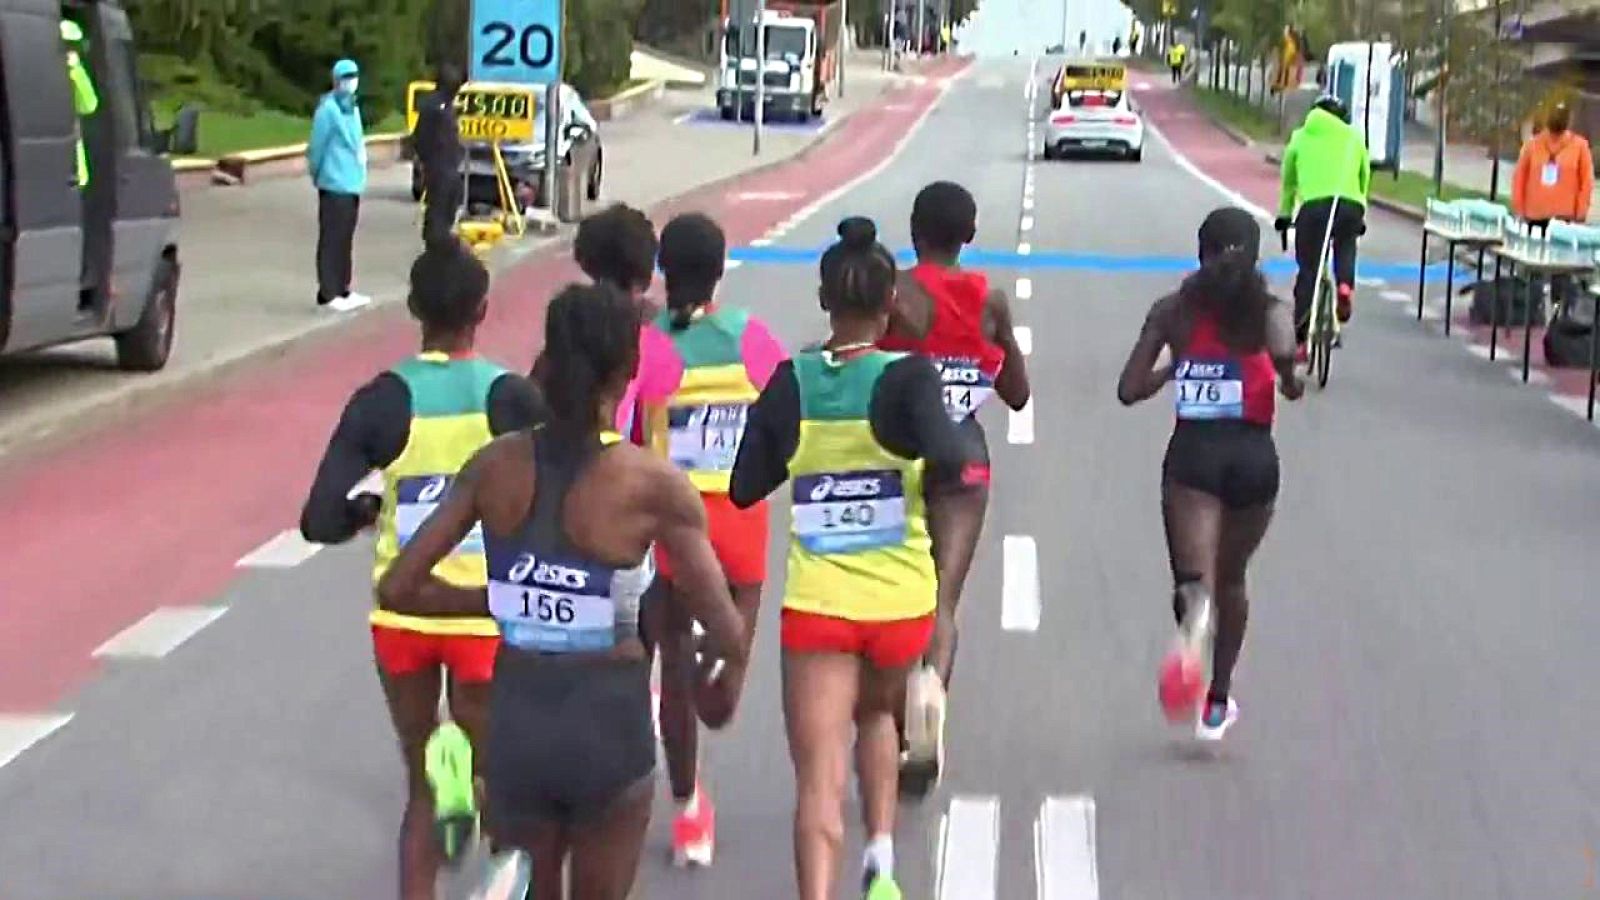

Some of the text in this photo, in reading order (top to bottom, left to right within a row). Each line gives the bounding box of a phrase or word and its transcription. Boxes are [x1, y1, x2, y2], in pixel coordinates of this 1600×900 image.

[481, 21, 554, 68] 20
[944, 389, 971, 409] 14
[1179, 383, 1220, 402] 176
[820, 503, 875, 528] 140
[518, 590, 574, 624] 156
